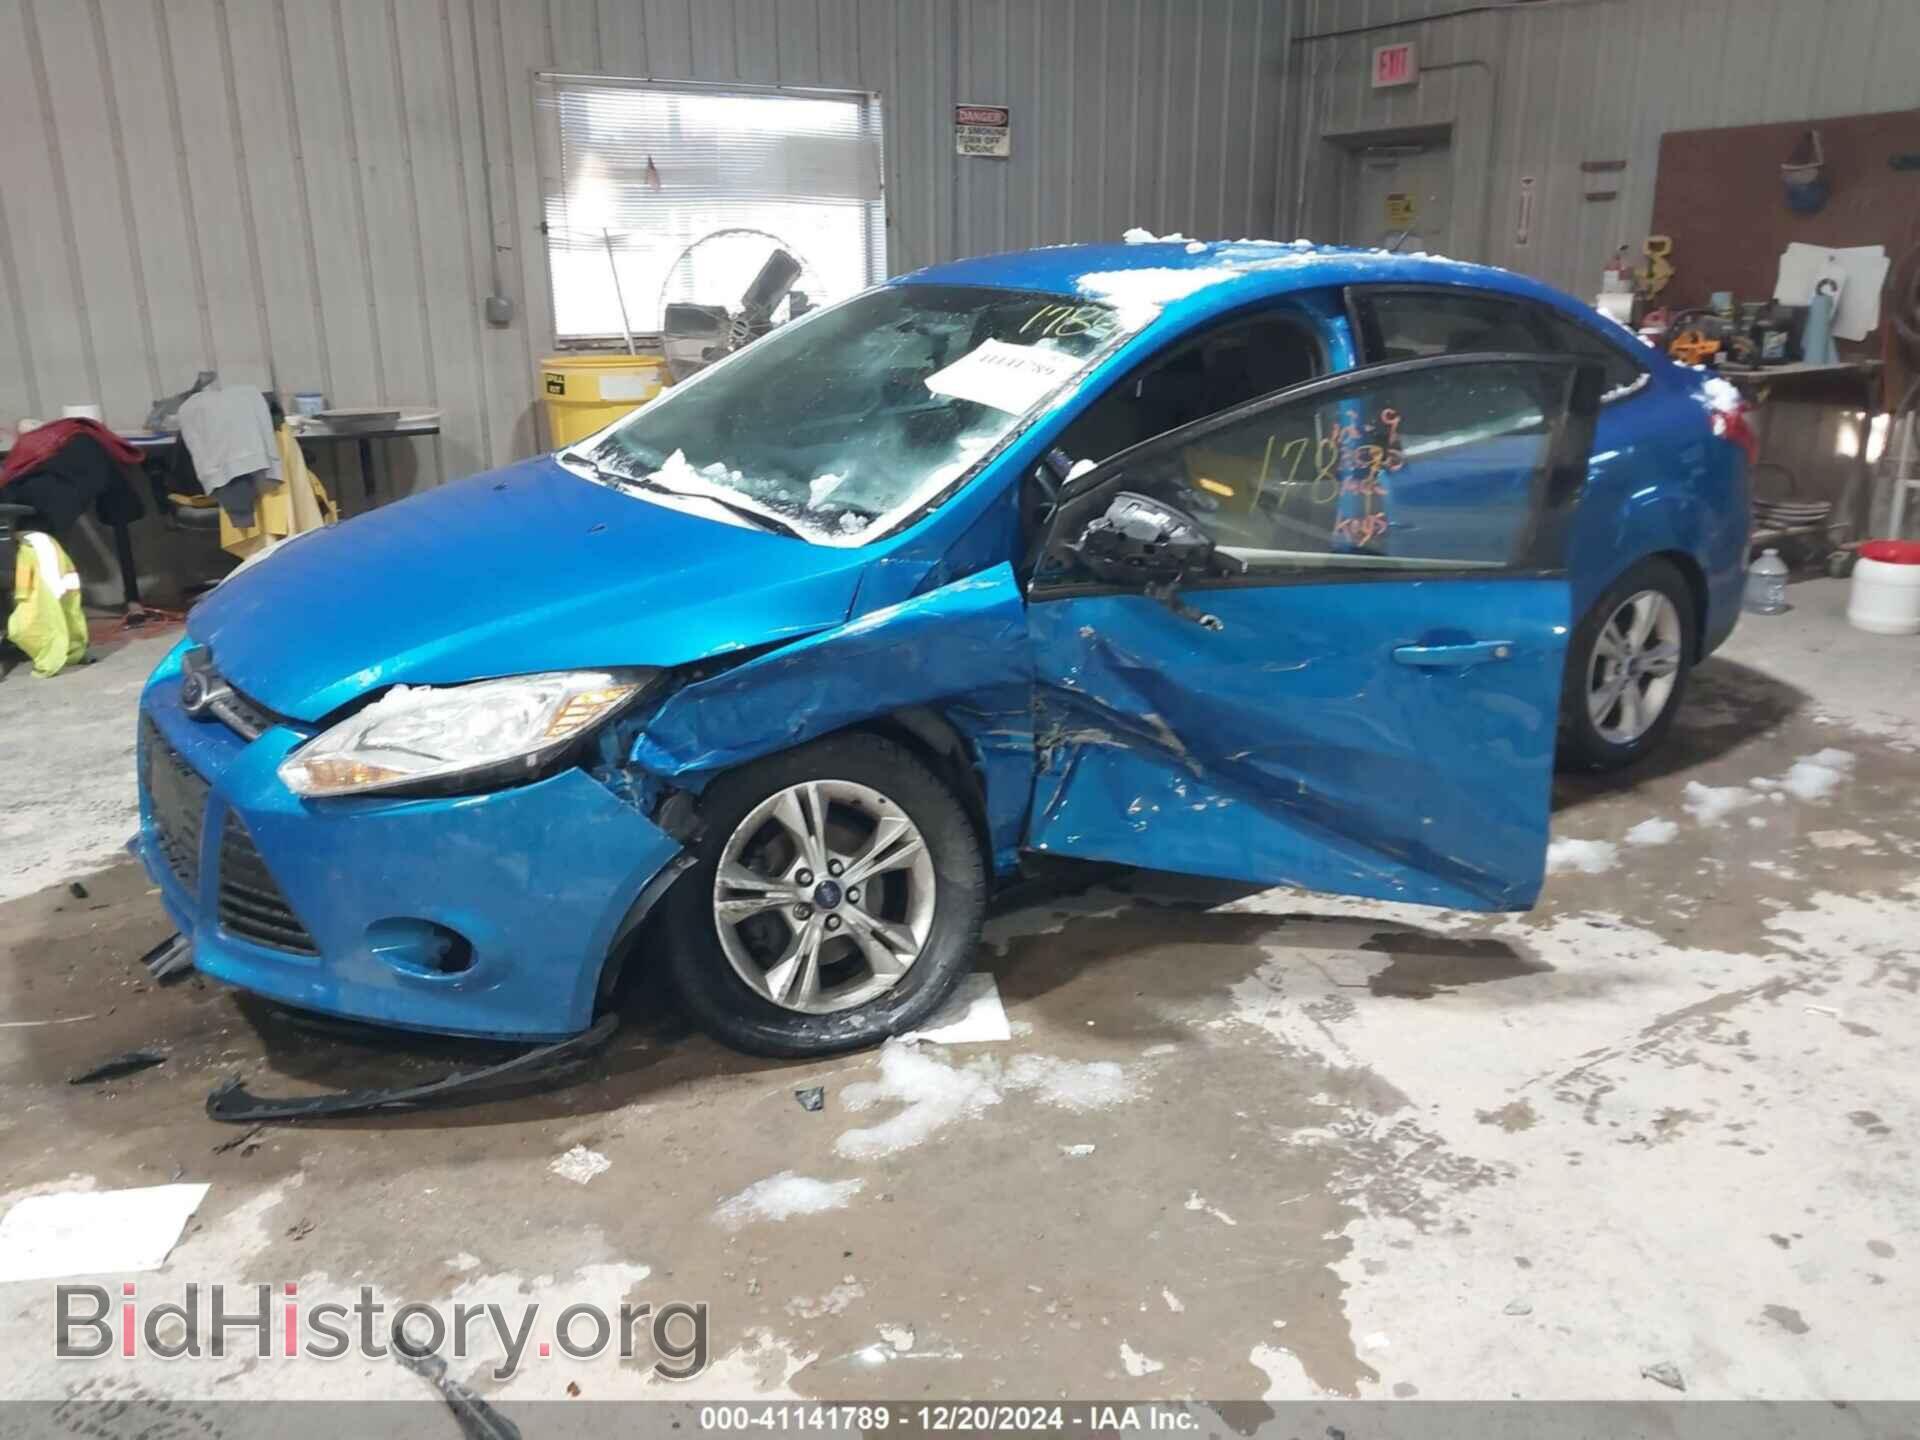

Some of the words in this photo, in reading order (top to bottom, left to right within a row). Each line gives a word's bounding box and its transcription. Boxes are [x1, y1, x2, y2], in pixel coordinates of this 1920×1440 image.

[1379, 47, 1408, 80] EXIT
[959, 110, 1002, 122] DANGER
[967, 127, 1007, 136] SMOKING
[963, 144, 996, 153] ENGINE
